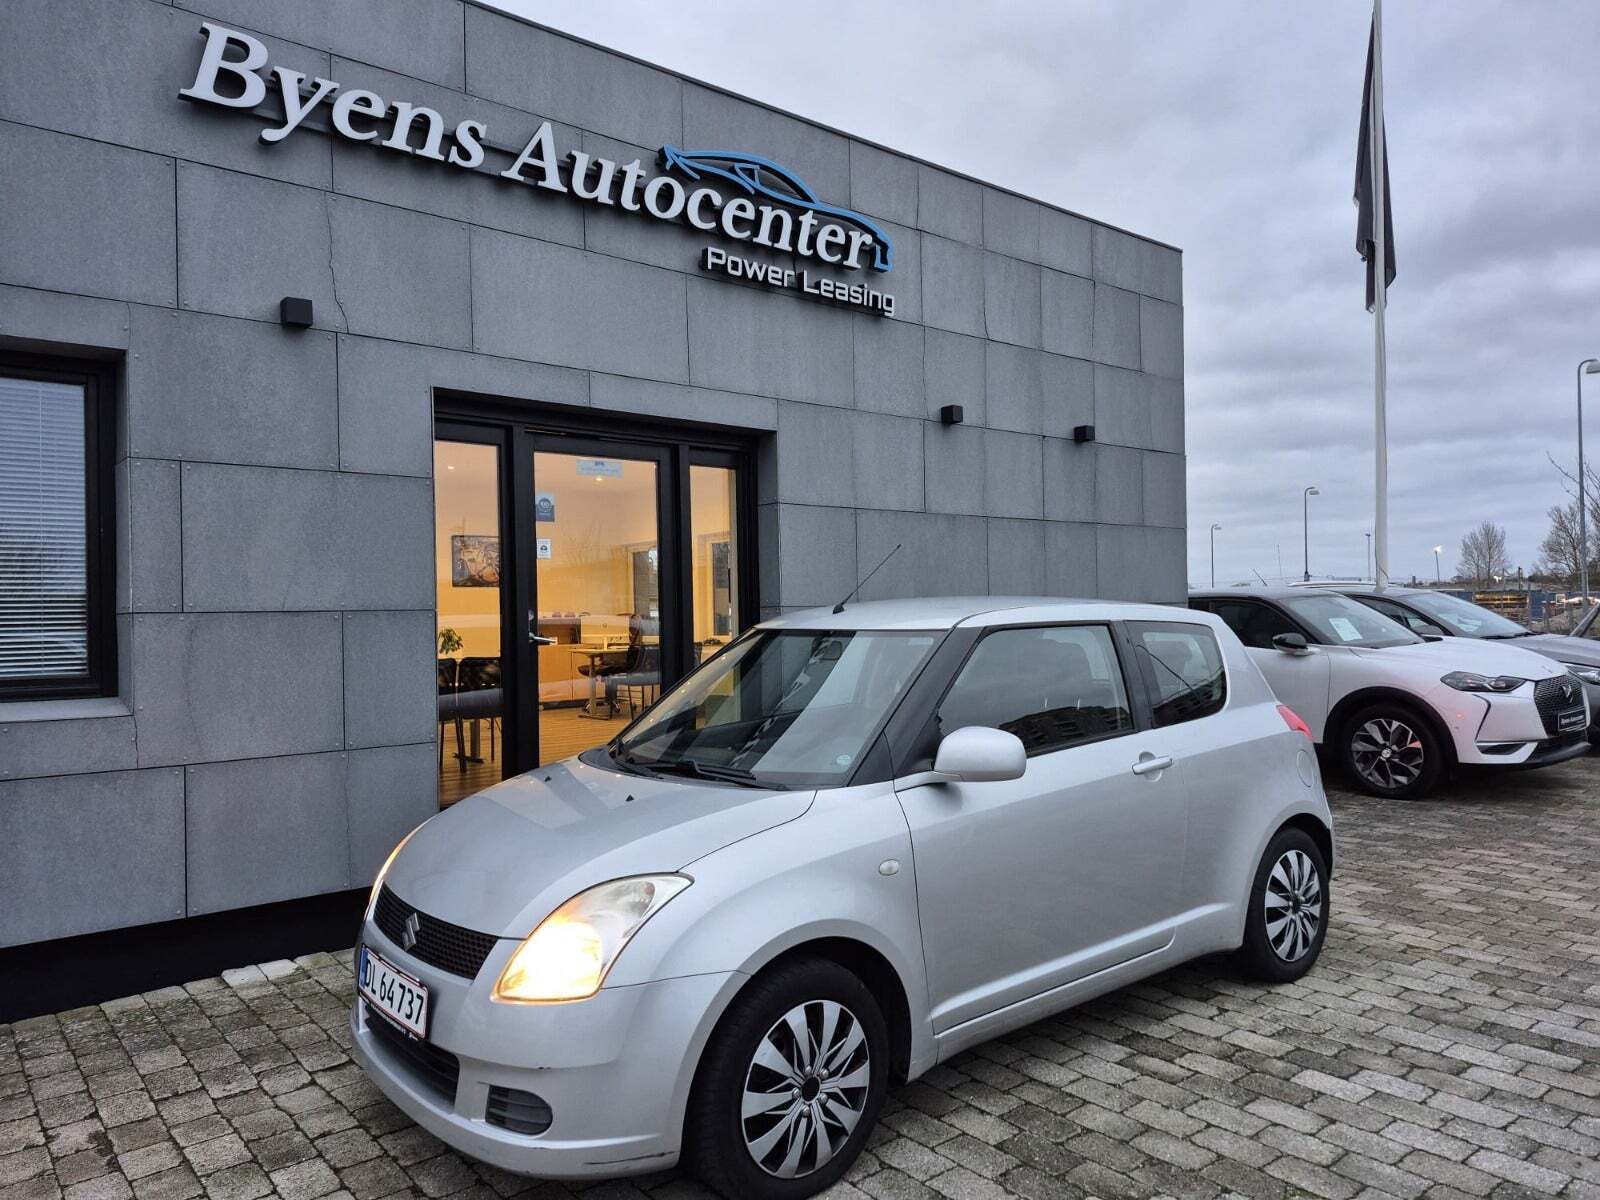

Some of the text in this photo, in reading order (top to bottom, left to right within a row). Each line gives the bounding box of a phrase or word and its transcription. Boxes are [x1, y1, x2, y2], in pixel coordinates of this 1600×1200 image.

[179, 22, 873, 269] Byens Autocenter
[706, 247, 896, 317] Power Leasing
[365, 958, 377, 996] DL
